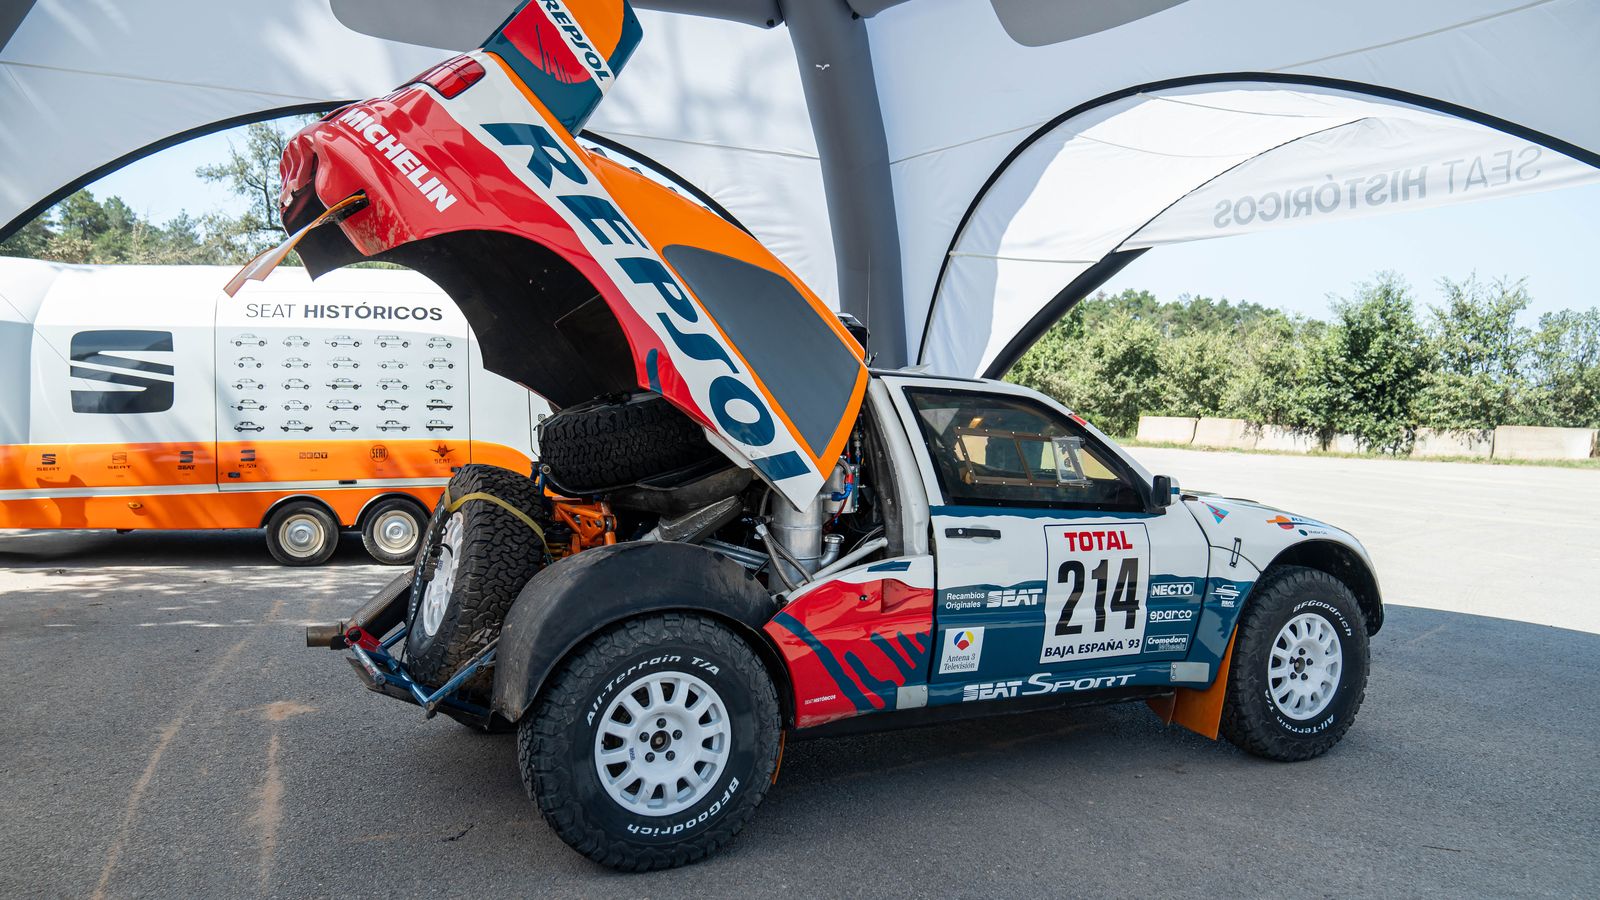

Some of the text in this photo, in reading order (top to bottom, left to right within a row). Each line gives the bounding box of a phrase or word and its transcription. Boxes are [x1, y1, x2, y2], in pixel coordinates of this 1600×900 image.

[541, 0, 610, 81] REPSOL
[340, 108, 458, 213] MICHELIN
[246, 301, 443, 321] SEAT HISTÓRICOS
[299, 451, 328, 459] SEAT
[372, 447, 387, 459] SEAT
[1064, 531, 1133, 552] TOTAL
[946, 592, 985, 600] Recambios
[986, 588, 1043, 608] SEAT
[1055, 557, 1140, 636] 214
[1152, 584, 1193, 596] NECTO
[946, 601, 981, 610] Originales
[1150, 610, 1193, 623] sparco
[1293, 600, 1352, 637] BFGoodrich
[1044, 645, 1075, 659] BAJA
[1078, 638, 1123, 654] ESPAÑA
[1148, 636, 1187, 645] Cromodora
[944, 662, 975, 671] Televisión
[971, 653, 976, 661] 3
[586, 654, 721, 727] All-Terrain T/A
[962, 673, 1136, 701] SEAT SPORT
[1276, 713, 1334, 734] All-Terrain
[627, 776, 740, 837] BFGoodrich
